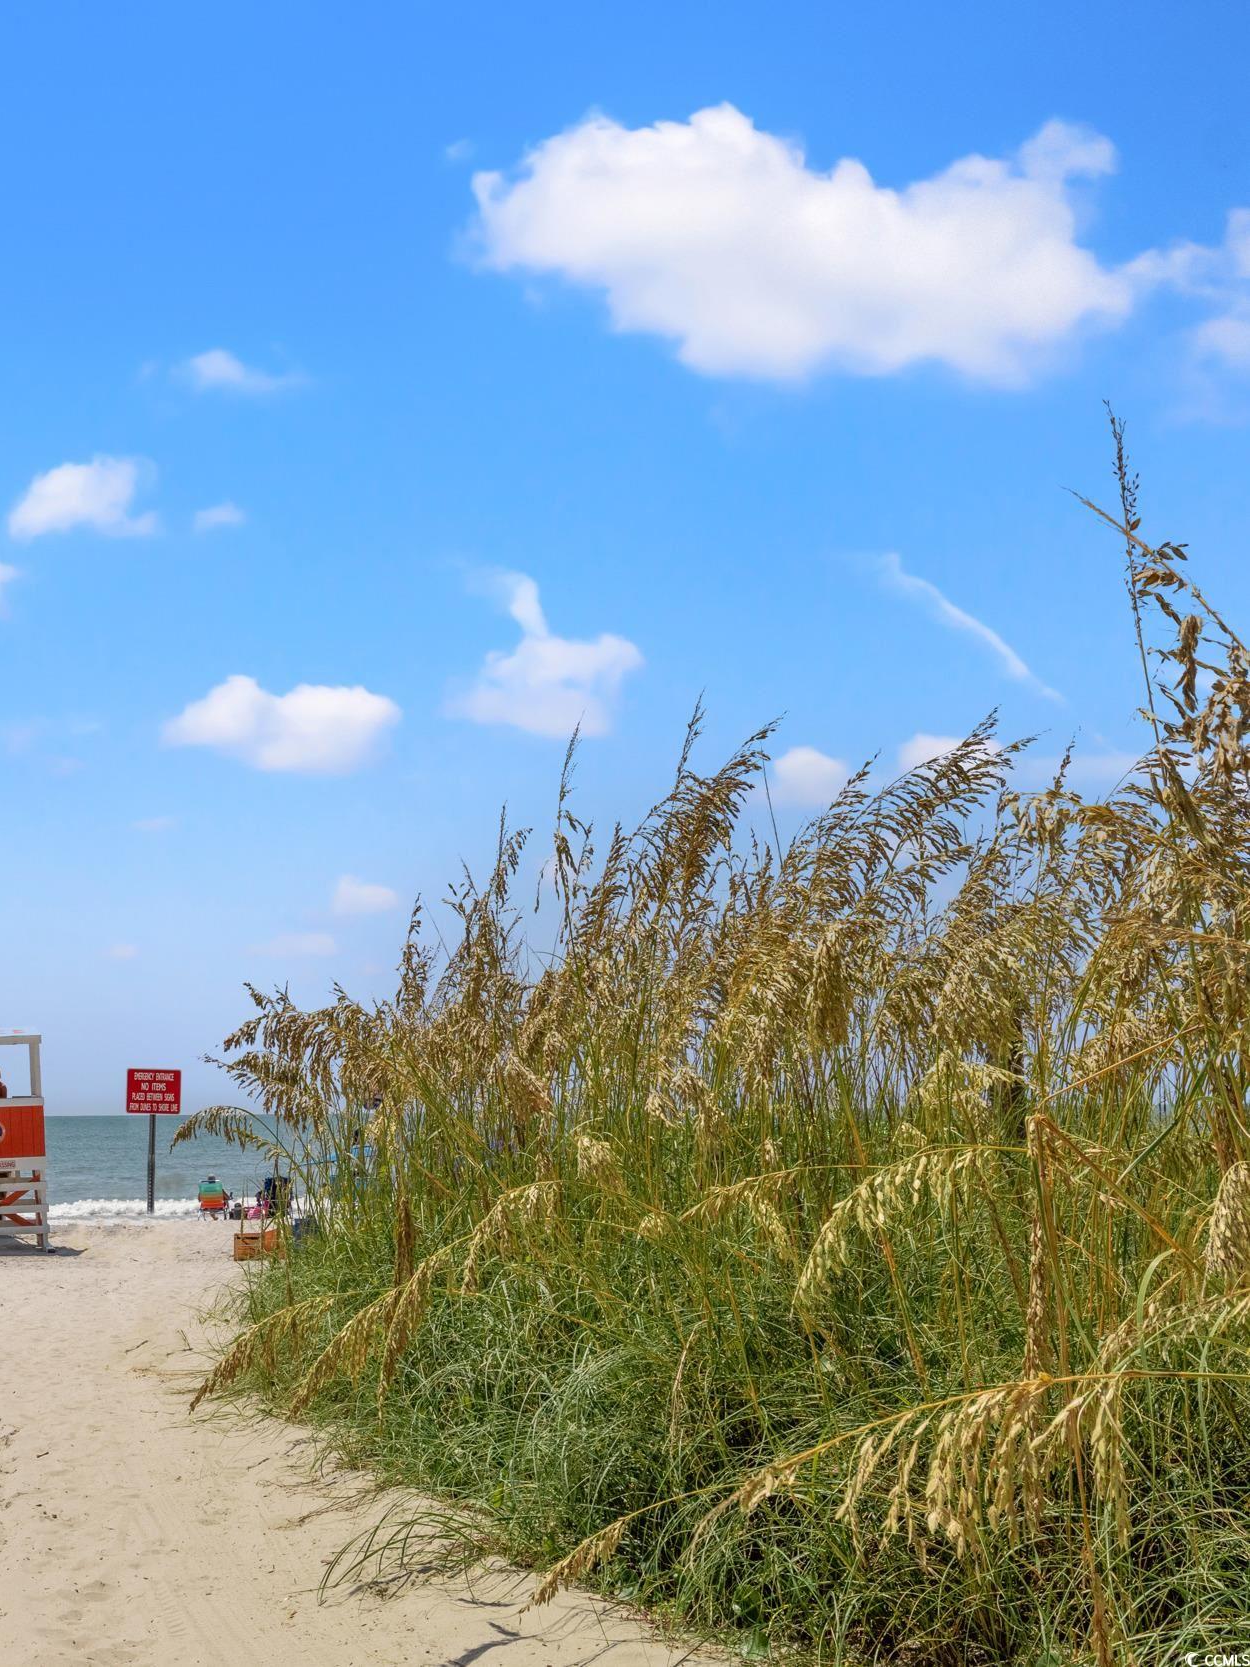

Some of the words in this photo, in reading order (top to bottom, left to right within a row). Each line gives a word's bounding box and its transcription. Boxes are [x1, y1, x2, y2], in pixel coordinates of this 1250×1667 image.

[134, 1072, 155, 1081] EMERGENCY
[155, 1072, 174, 1081] ENTRANCE
[141, 1082, 149, 1090] NO
[151, 1083, 166, 1091] ITEMS
[132, 1092, 145, 1101] PLACED
[146, 1092, 163, 1101] BETWEEN
[164, 1093, 175, 1101] SIGNS
[129, 1102, 139, 1111] FROM
[140, 1102, 151, 1111] DUNES
[152, 1103, 157, 1111] TO
[158, 1103, 169, 1111] SHORE
[170, 1103, 178, 1112] LINE
